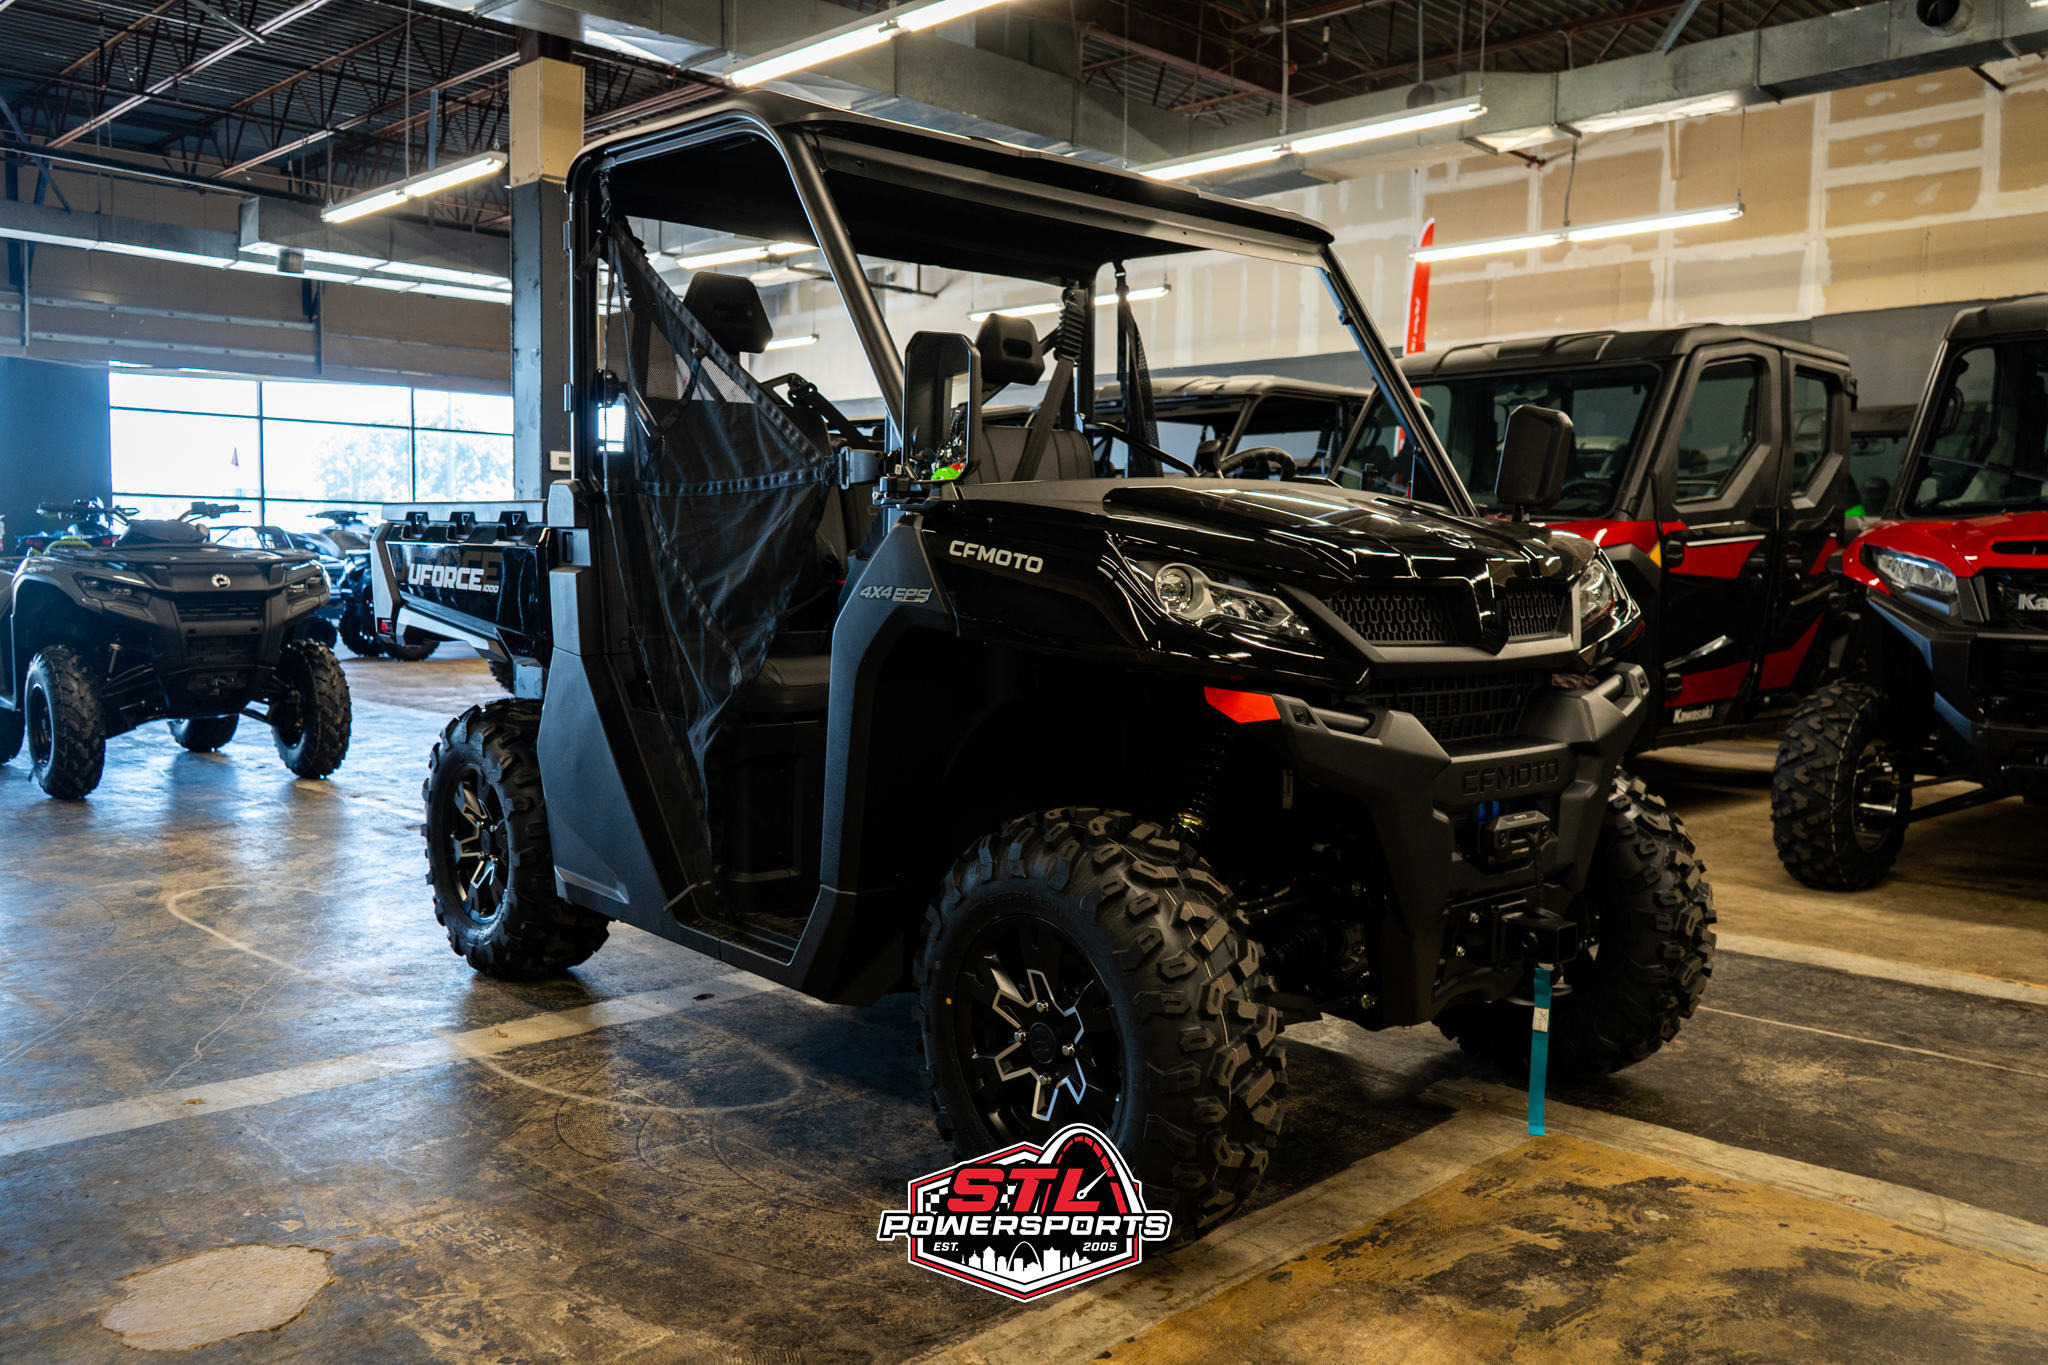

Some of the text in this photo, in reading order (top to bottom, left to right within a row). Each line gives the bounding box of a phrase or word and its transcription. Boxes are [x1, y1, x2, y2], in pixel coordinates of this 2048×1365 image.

[949, 540, 1044, 574] CFMOTO
[408, 563, 500, 594] UFORCE 1000
[1673, 704, 1715, 724] Kawasaki
[1461, 758, 1559, 796] CFMOTO
